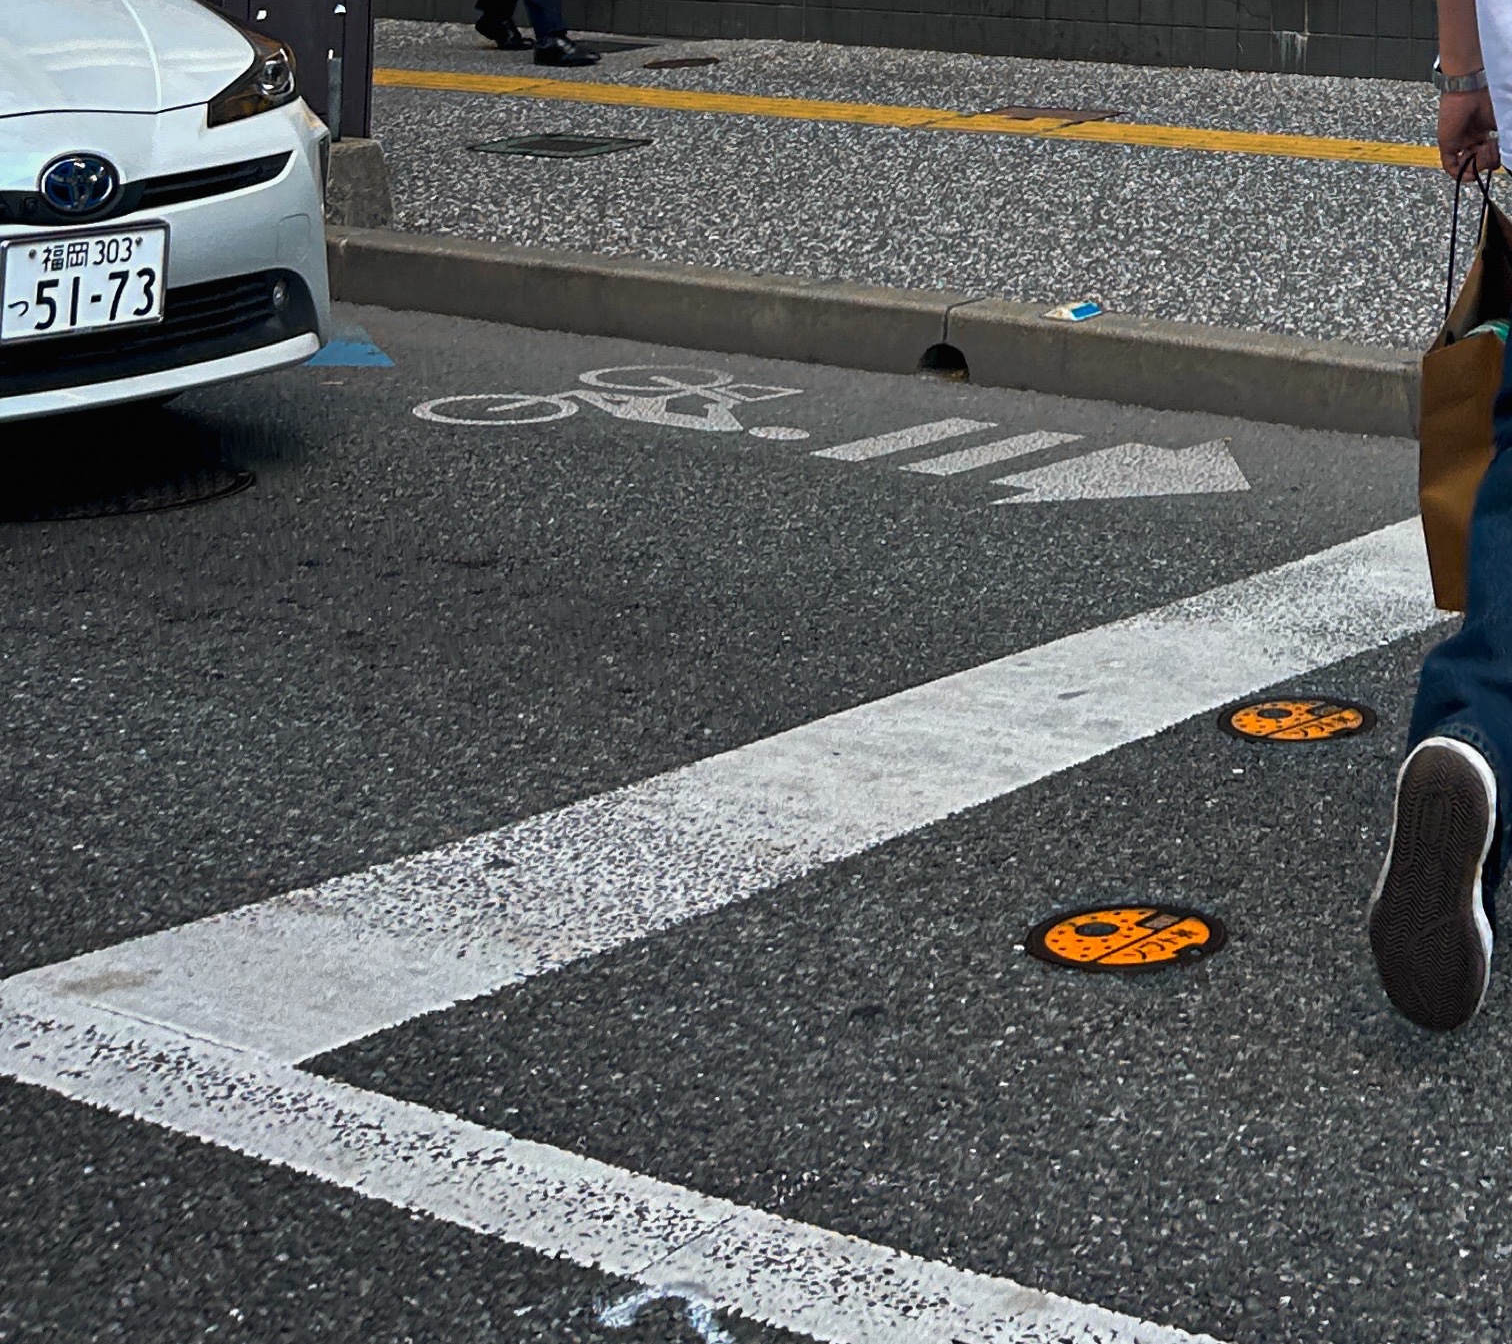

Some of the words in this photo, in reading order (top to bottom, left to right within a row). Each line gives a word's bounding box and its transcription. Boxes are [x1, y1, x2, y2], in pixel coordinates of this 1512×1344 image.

[42, 240, 90, 273] 福岡
[92, 236, 133, 266] 303
[8, 299, 30, 317] つ
[34, 266, 156, 331] 51-73
